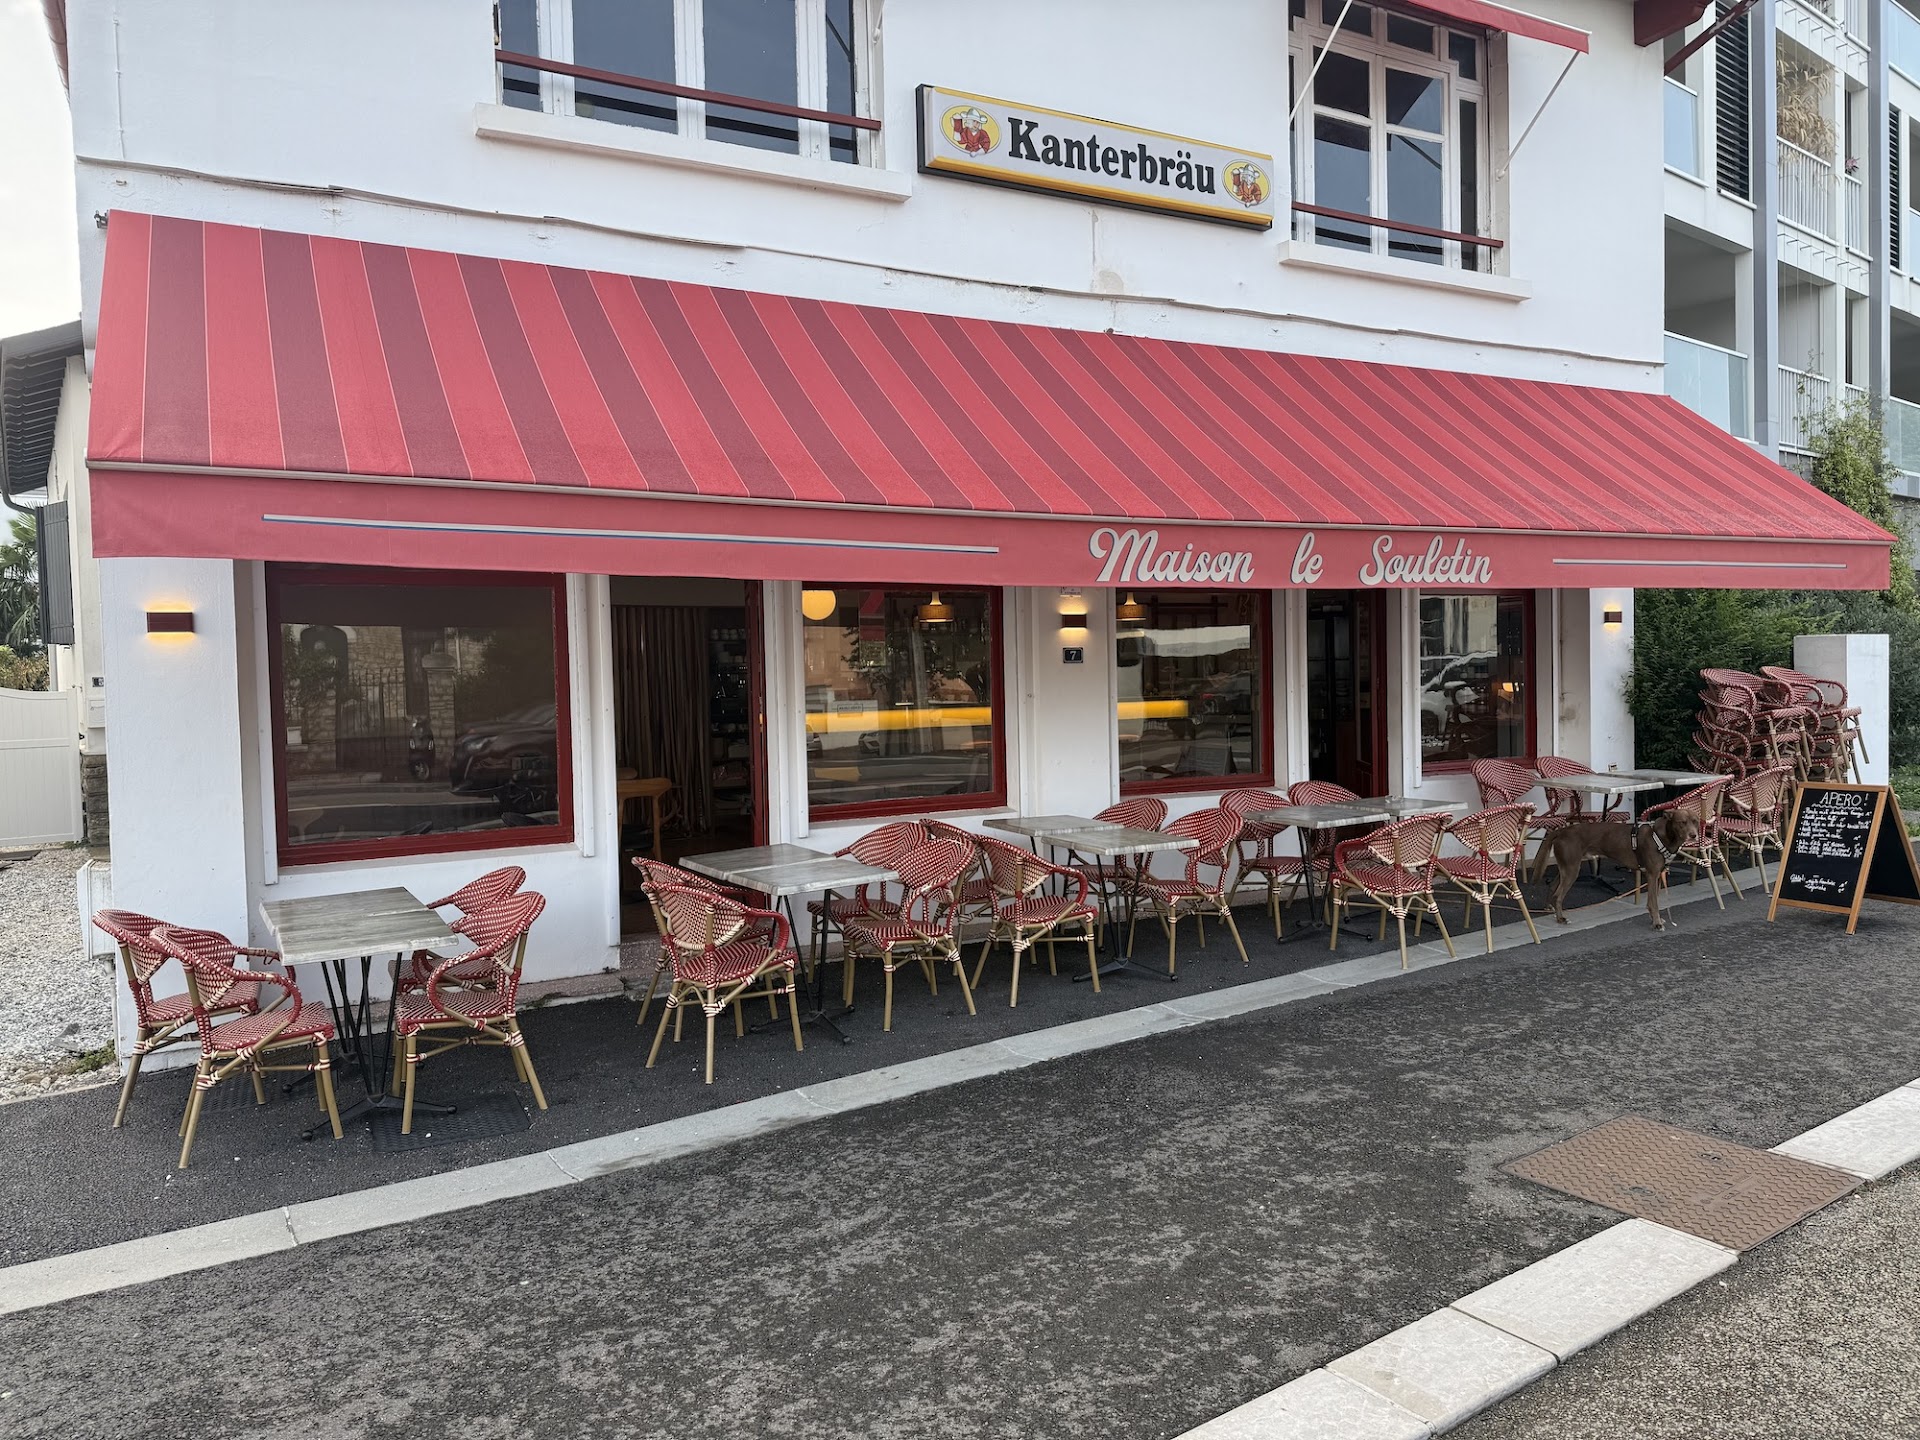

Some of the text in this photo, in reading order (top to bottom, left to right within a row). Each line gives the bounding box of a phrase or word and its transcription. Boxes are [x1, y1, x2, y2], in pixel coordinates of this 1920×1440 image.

[1007, 116, 1216, 194] Kanterbräu
[1088, 528, 1493, 586] Maison le Souletin
[1069, 650, 1077, 660] 7
